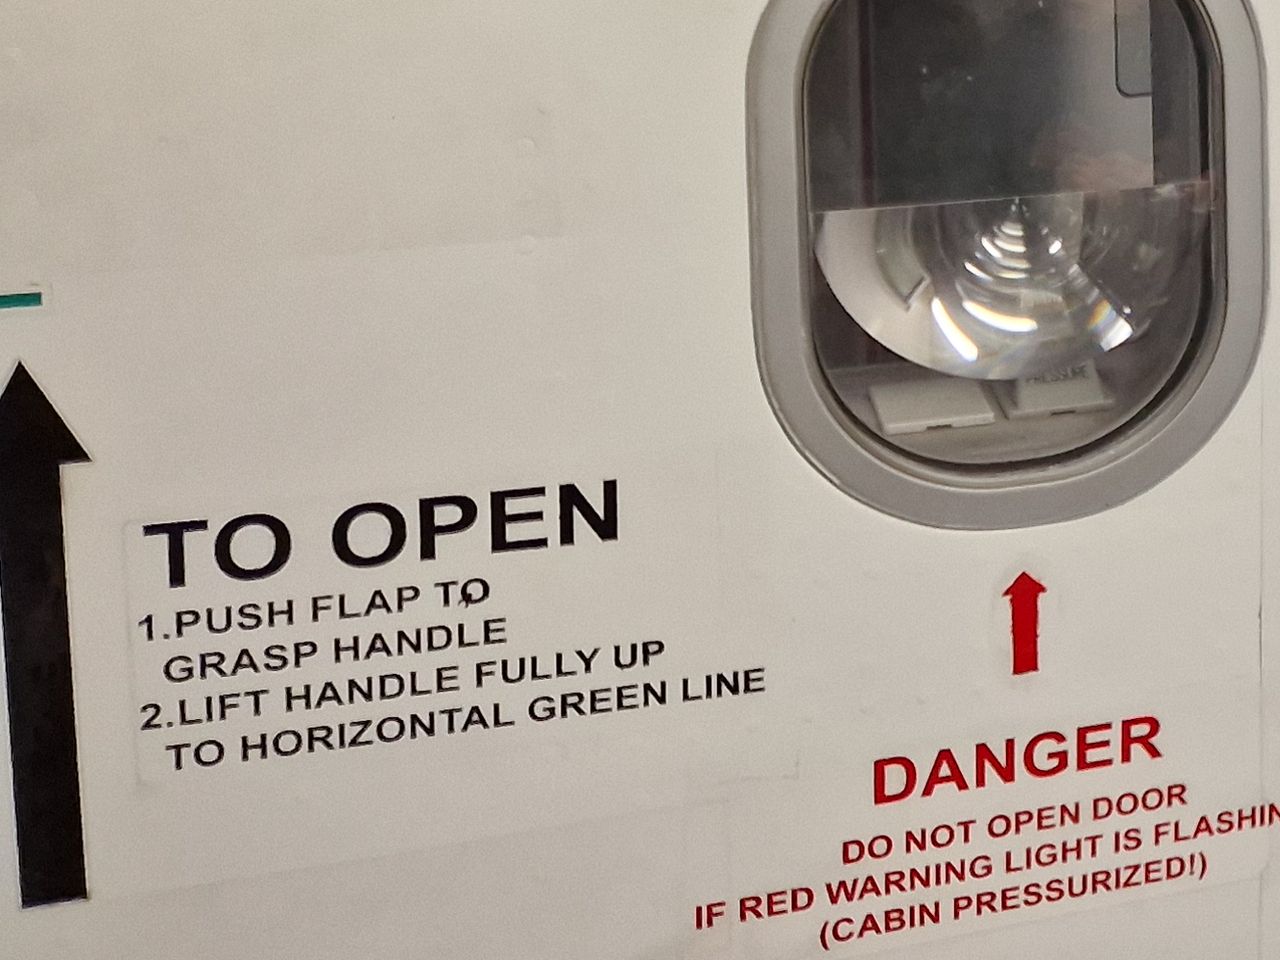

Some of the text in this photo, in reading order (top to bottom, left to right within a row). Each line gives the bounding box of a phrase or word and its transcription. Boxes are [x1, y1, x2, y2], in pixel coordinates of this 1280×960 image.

[143, 479, 617, 588] TO OPEN
[139, 578, 489, 641] 1.PUSH FLAP TO
[163, 618, 506, 682] GRASP HANDLE
[141, 641, 664, 730] 2.LIFT HANDLE FULLY UP
[166, 668, 765, 770] TO HORIZONTAL GREEN LINE
[873, 714, 1162, 807] DANGER
[842, 784, 1187, 865] DO NOT OPEN DOOR
[694, 901, 727, 929] IF
[740, 887, 816, 923] RED
[825, 854, 994, 905] WARNING
[1004, 835, 1103, 874] LIGHT
[1113, 828, 1143, 854] IS
[820, 854, 1209, 951] (CABIN PRESSURIZED!)
